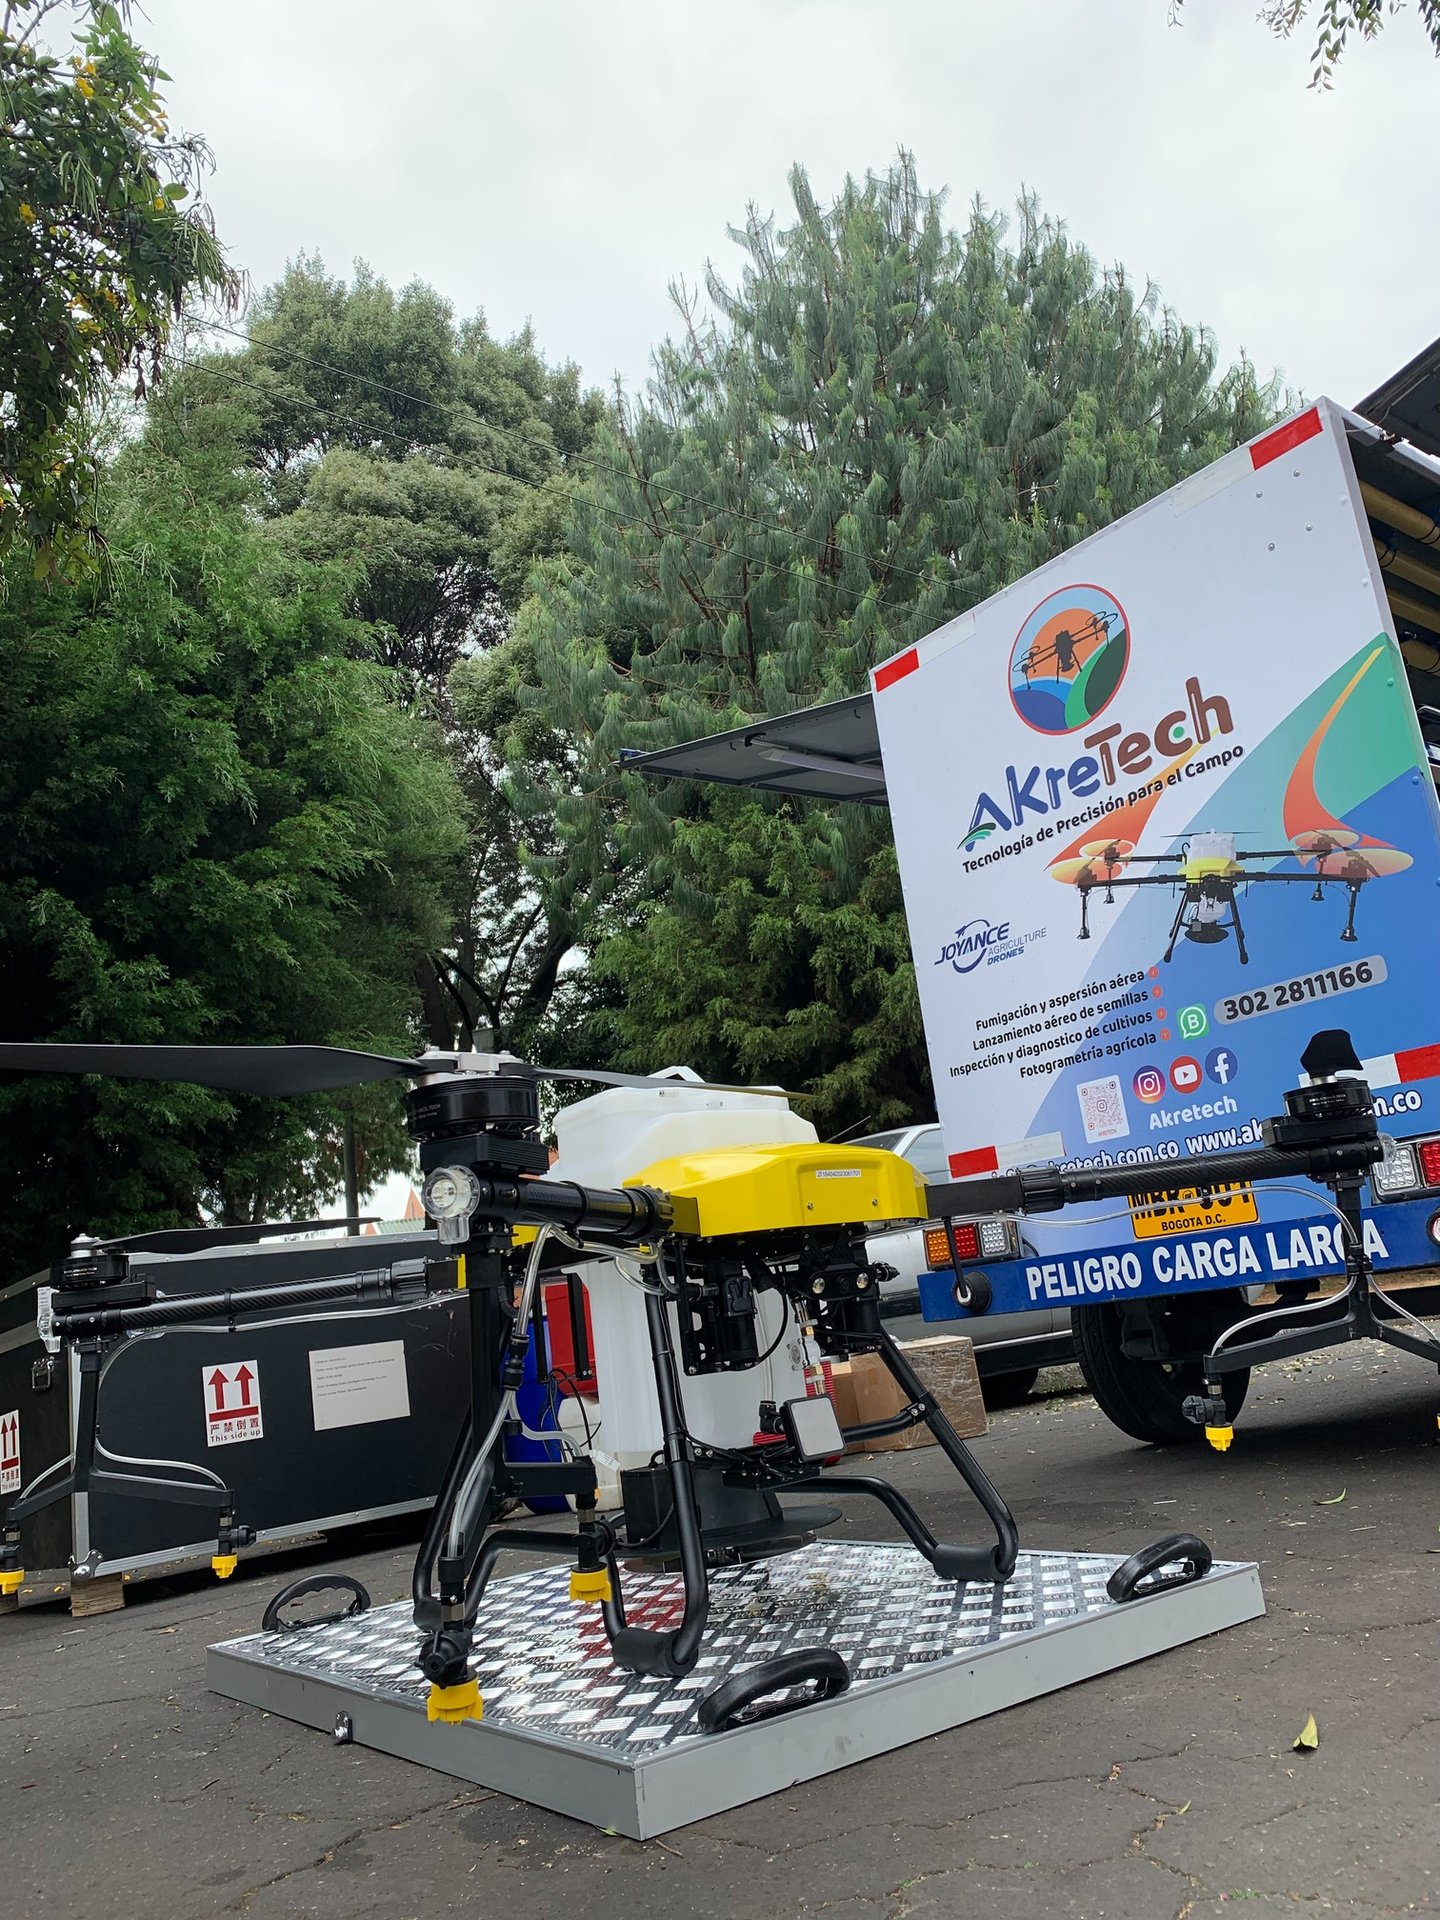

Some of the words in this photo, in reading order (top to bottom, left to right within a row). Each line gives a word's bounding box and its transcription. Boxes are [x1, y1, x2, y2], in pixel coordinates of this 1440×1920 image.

[962, 832, 1034, 874] Tecnología
[1036, 826, 1054, 843] de
[1056, 795, 1125, 834] Precisión
[1127, 781, 1163, 807] para
[1167, 768, 1183, 786] el
[1185, 745, 1245, 779] Campo
[934, 922, 1010, 965] JOYANCE
[987, 945, 1025, 966] DRONES
[988, 927, 1047, 957] AGRICULTURE
[975, 1003, 1038, 1031] Fumigación
[1040, 1001, 1047, 1014] y
[1048, 980, 1107, 1008] aspersión
[1109, 970, 1145, 990] aérea
[1223, 991, 1270, 1020] 302
[1273, 961, 1373, 1007] 2811166
[973, 1022, 1042, 1051] Lanzamiento
[1044, 1012, 1078, 1030] aéreo
[1080, 1006, 1095, 1019] de
[1097, 990, 1149, 1015] semillas
[949, 1053, 1005, 1078] Inspección
[1007, 1051, 1014, 1064] y
[1016, 1032, 1083, 1059] diagnostico
[1085, 1026, 1100, 1040] de
[1102, 1011, 1153, 1034] cultivos
[1020, 1045, 1104, 1079] Fotogrametría
[1105, 1032, 1157, 1057] agrícola
[1149, 1095, 1238, 1130] Akretech
[1161, 1217, 1203, 1231] BOGOTA
[1205, 1213, 1227, 1226] D.C.
[1025, 1252, 1142, 1300] PELIGRO
[1153, 1235, 1262, 1283] CARGA
[211, 1435, 228, 1443] This
[231, 1431, 248, 1440] side
[250, 1429, 261, 1437] up
